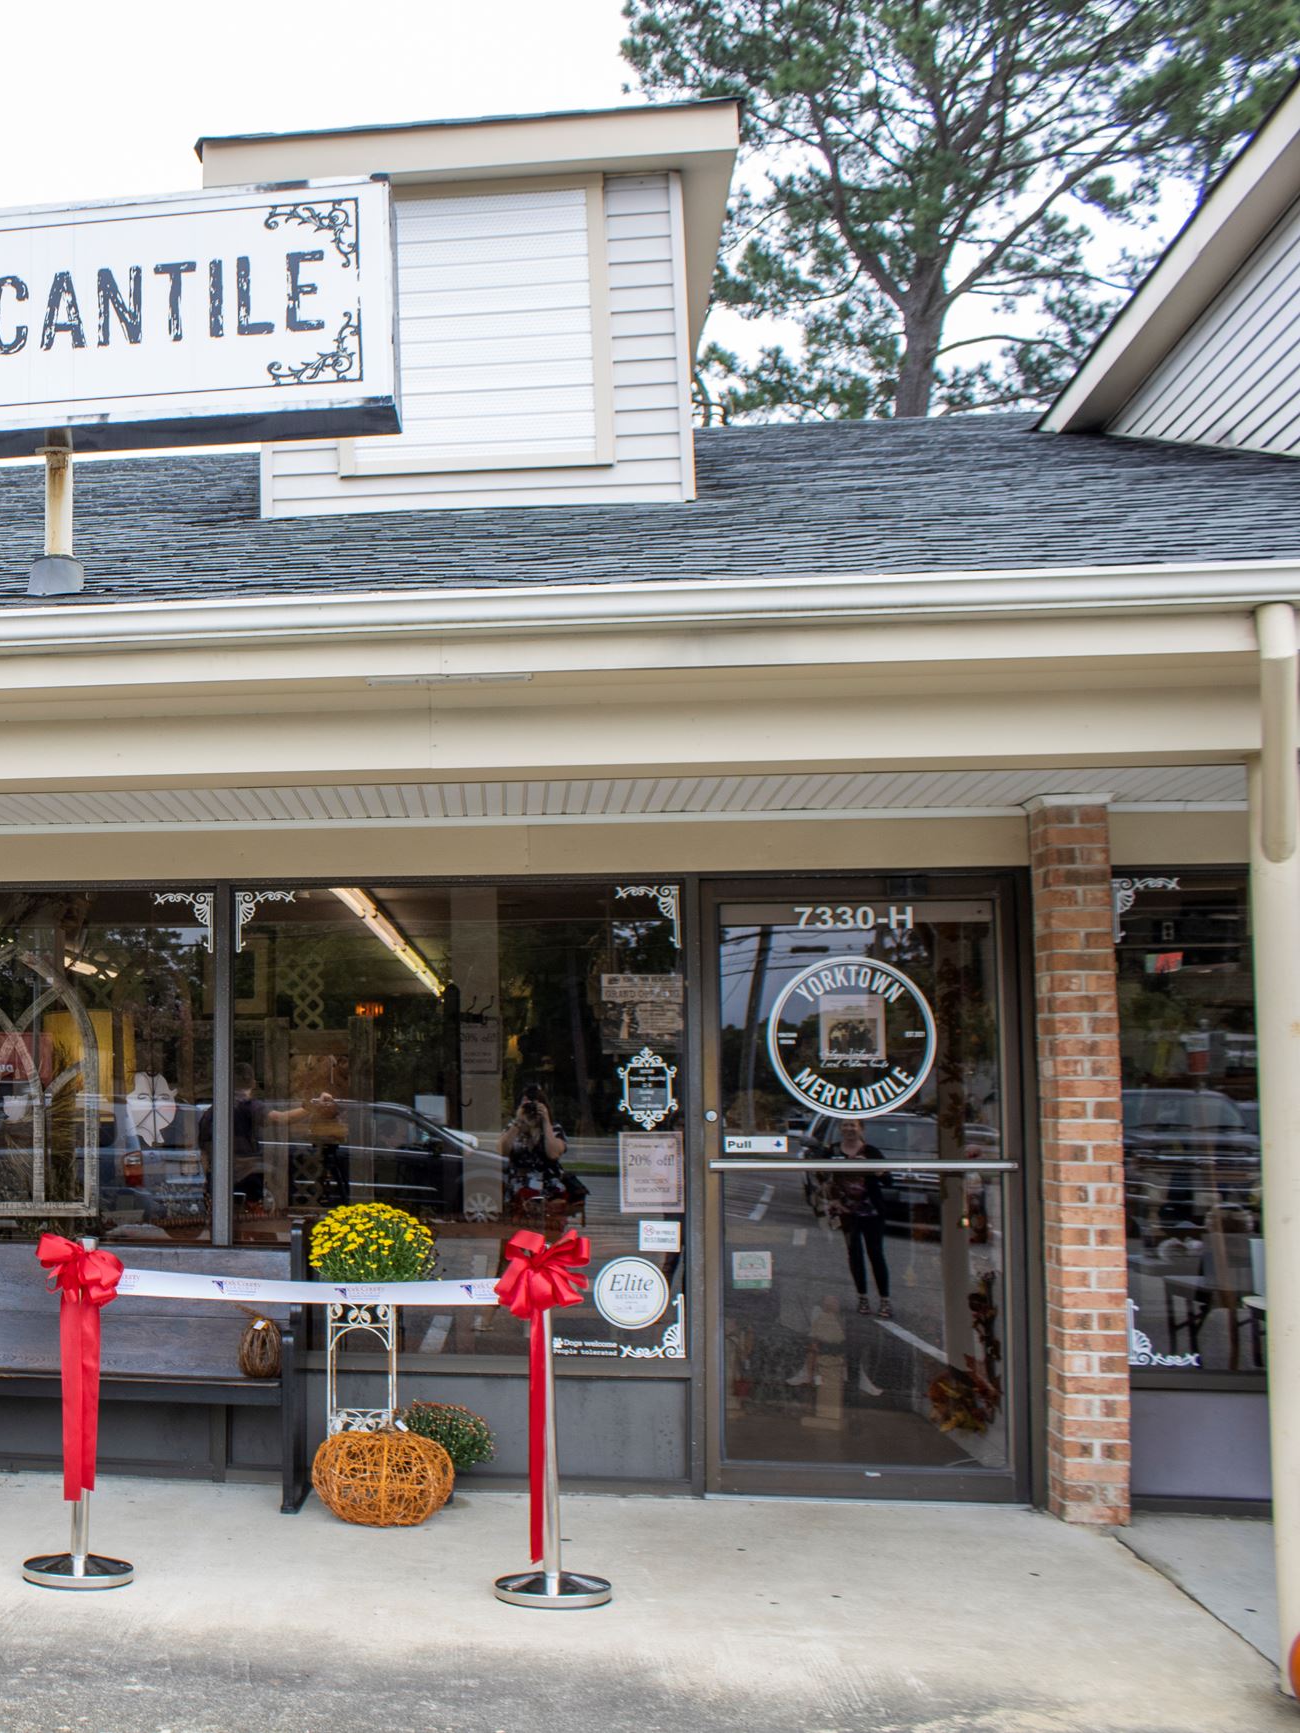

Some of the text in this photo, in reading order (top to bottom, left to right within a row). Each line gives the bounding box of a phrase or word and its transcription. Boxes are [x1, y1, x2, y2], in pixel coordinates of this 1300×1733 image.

[793, 905, 914, 931] 7330-H
[795, 965, 906, 1004] YORKTOWN
[793, 1066, 915, 1110] MERCANTILE
[727, 1140, 752, 1149] Pull
[628, 1154, 652, 1167] 20%
[609, 1273, 654, 1292] Elite
[552, 1348, 618, 1356] People tolerated
[563, 1339, 618, 1349] Dogs welcome
